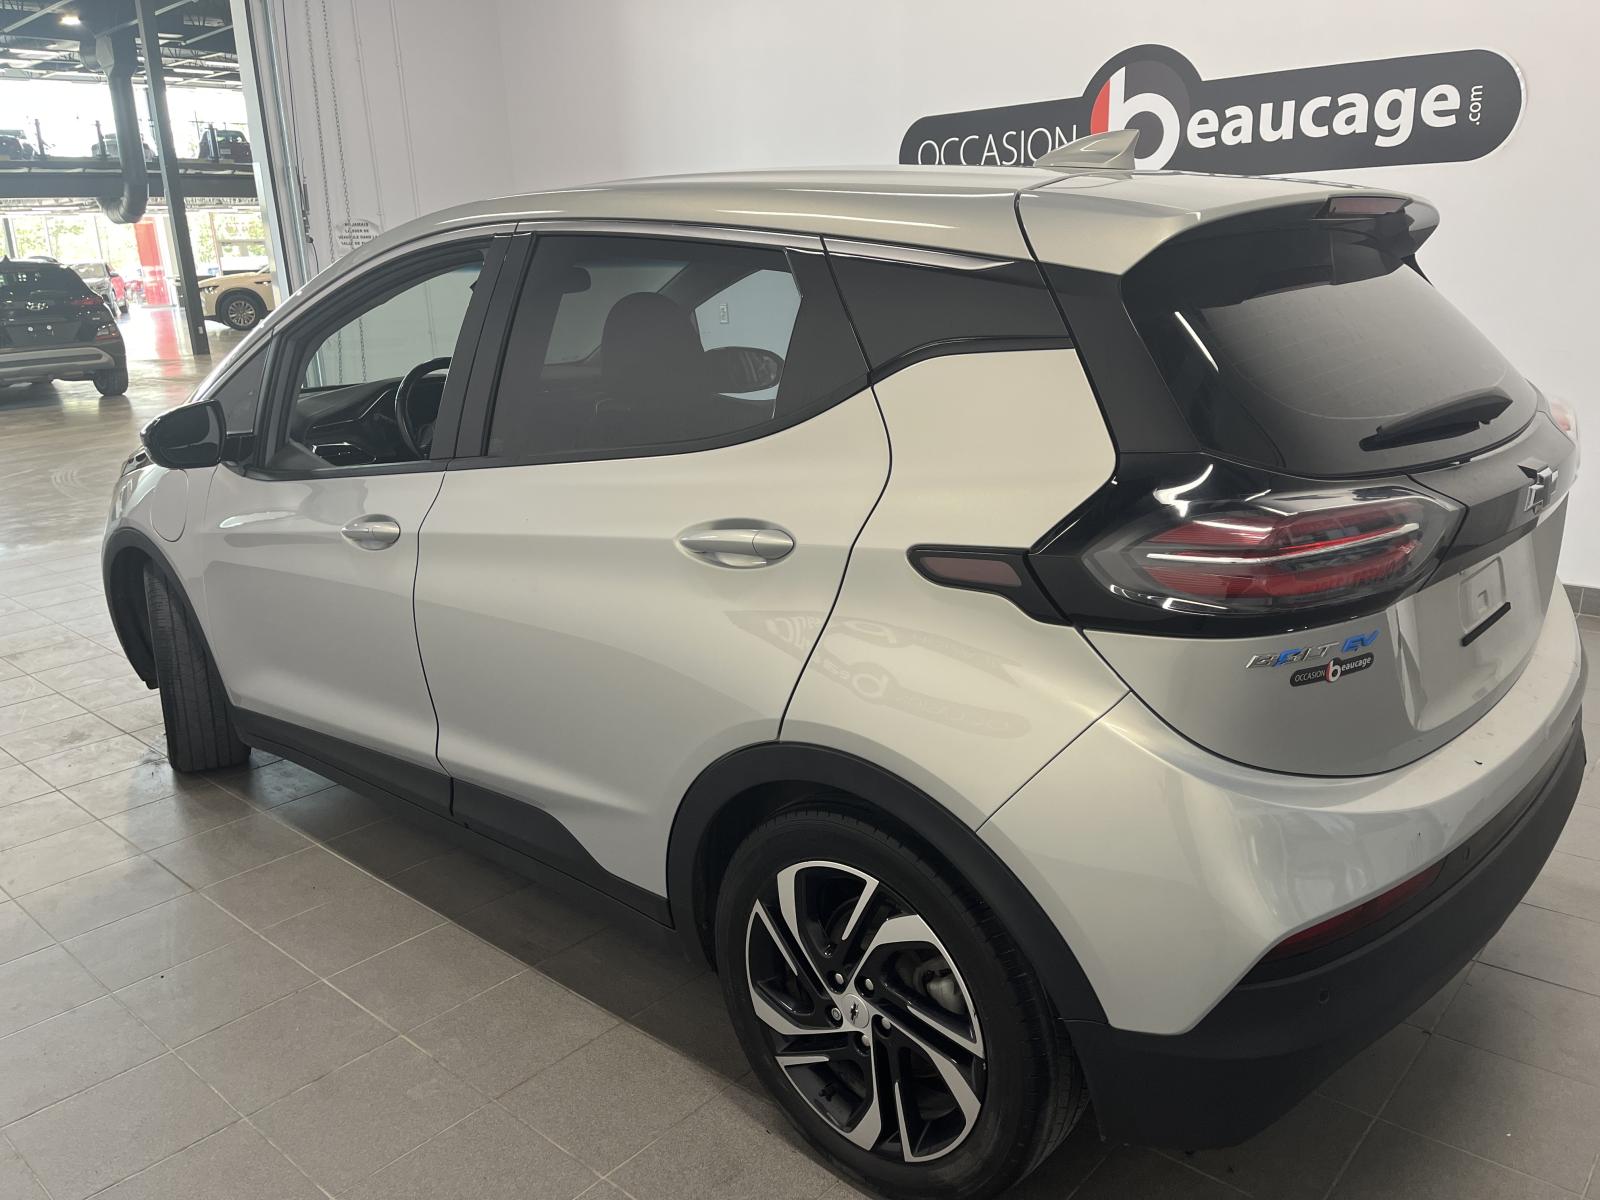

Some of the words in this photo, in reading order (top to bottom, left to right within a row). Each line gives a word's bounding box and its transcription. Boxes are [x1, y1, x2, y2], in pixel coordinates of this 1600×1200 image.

[918, 124, 1077, 165] OCCASION
[1468, 85, 1483, 126] .com
[1342, 629, 1379, 652] EV
[1294, 669, 1326, 683] OCCASION
[1328, 656, 1372, 683] beaucage
